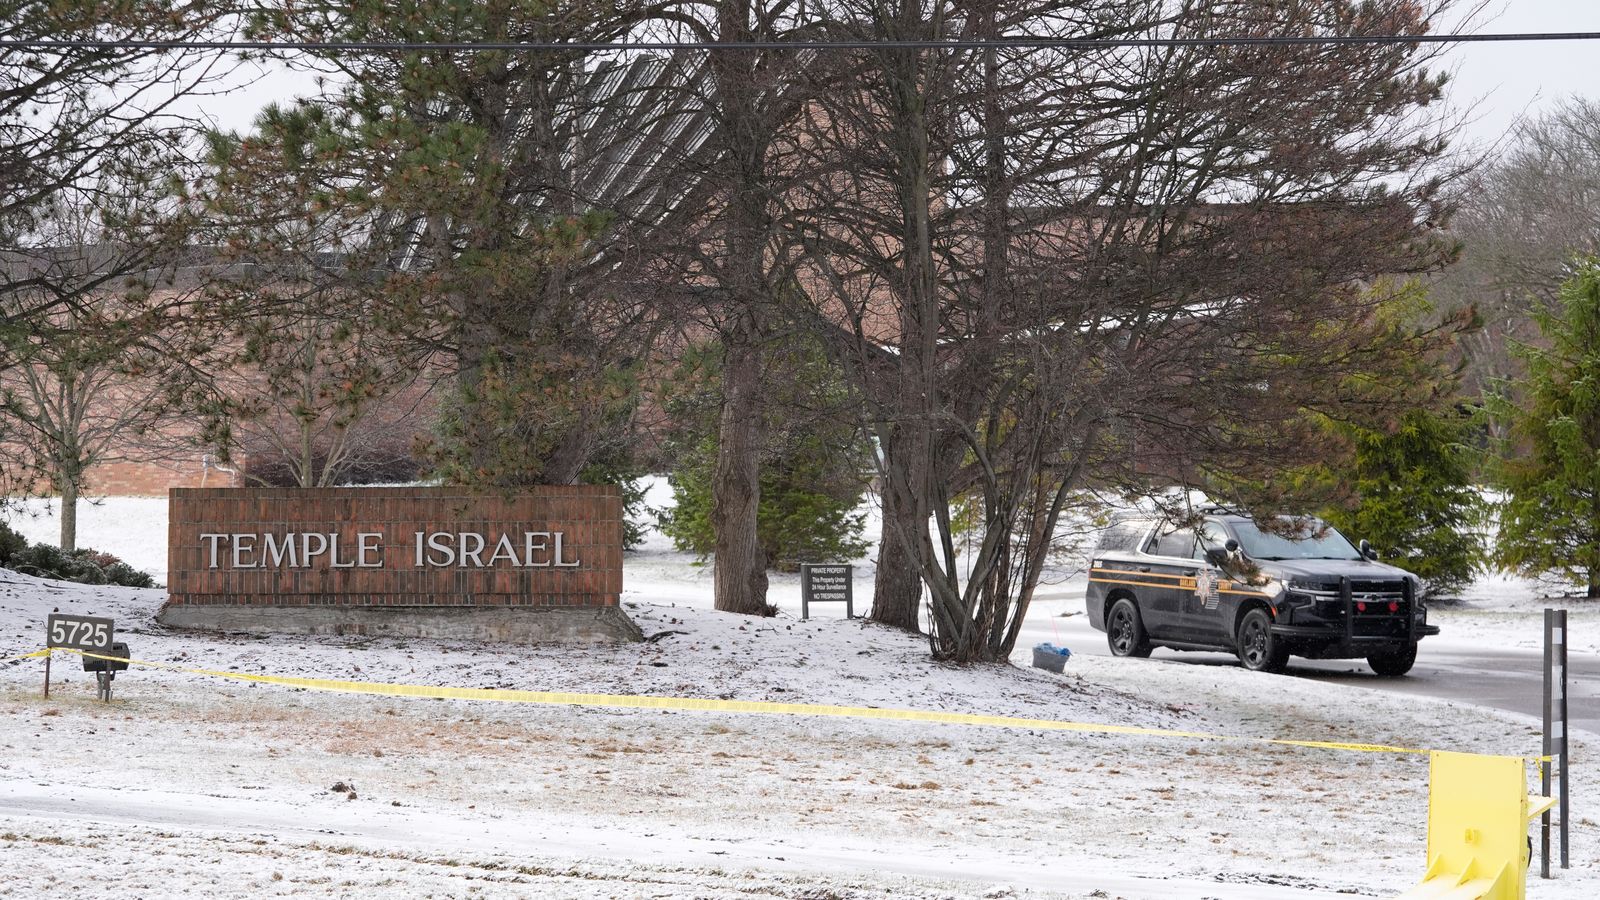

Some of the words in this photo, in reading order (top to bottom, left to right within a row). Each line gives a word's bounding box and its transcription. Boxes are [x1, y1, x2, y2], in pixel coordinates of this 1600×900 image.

[199, 532, 384, 569] TEMPLE
[414, 531, 580, 567] ISRAEL
[51, 619, 108, 648] 5725
